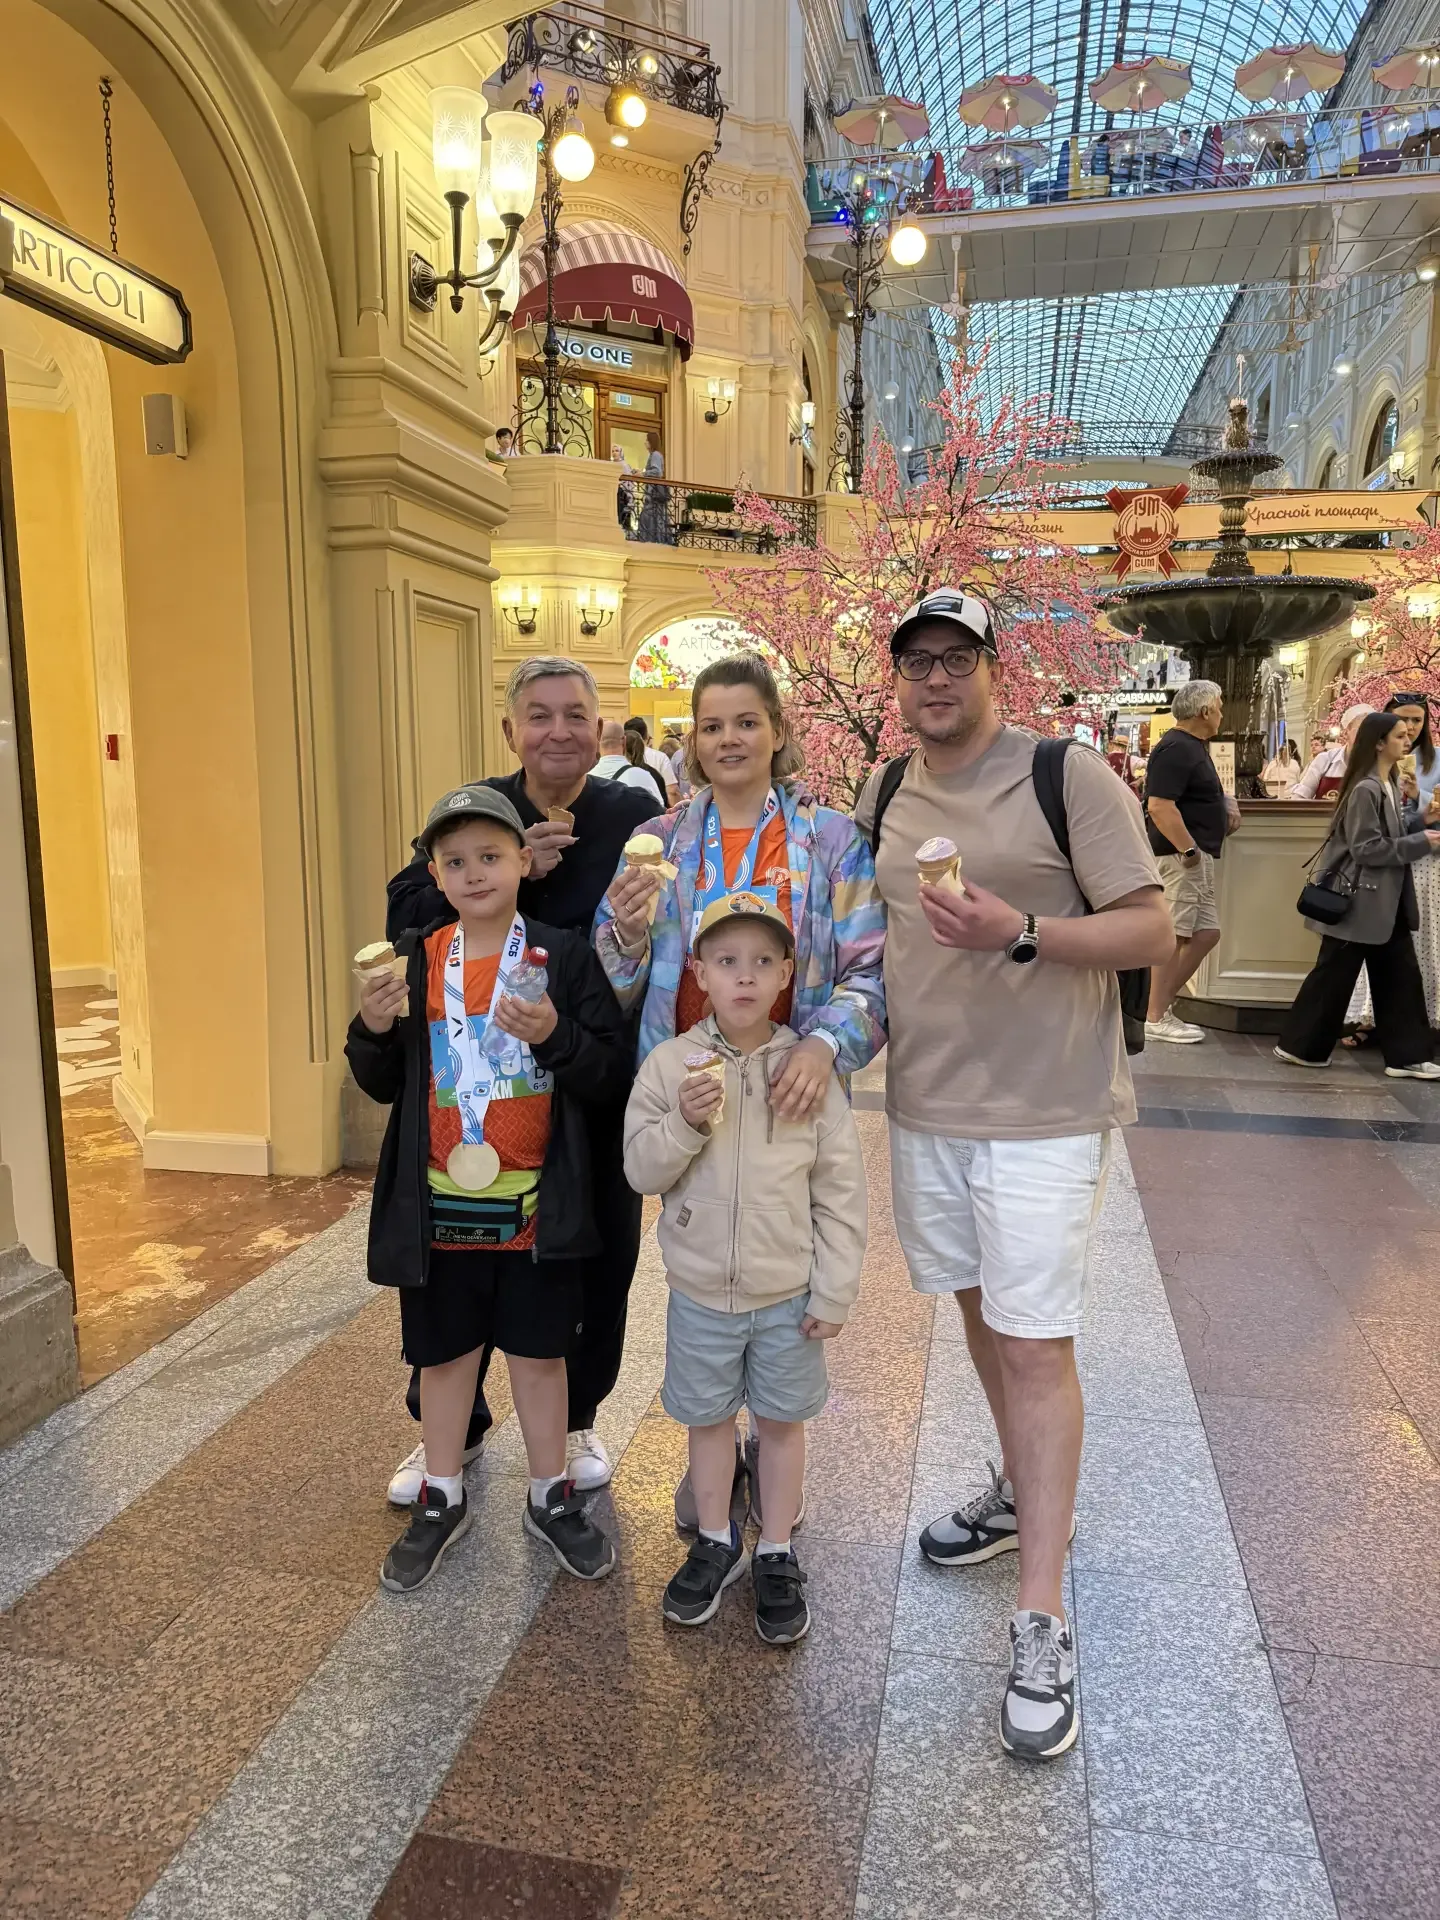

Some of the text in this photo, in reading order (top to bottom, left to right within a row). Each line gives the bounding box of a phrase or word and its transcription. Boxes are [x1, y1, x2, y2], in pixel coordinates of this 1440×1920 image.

[557, 340, 633, 366] NO ONE
[1134, 496, 1161, 516] ГУМ
[1246, 504, 1310, 526] Красной
[1314, 506, 1379, 521] площади
[1121, 540, 1144, 555] КРАСНАЯ
[1134, 558, 1155, 568] GUM
[1117, 692, 1168, 704] GABBANA
[707, 816, 717, 837] ПСБ
[451, 935, 461, 956] ПСБ
[508, 937, 521, 958] ПСБ
[535, 1067, 546, 1079] D
[533, 1082, 548, 1090] 6-9
[425, 1510, 440, 1518] GSD
